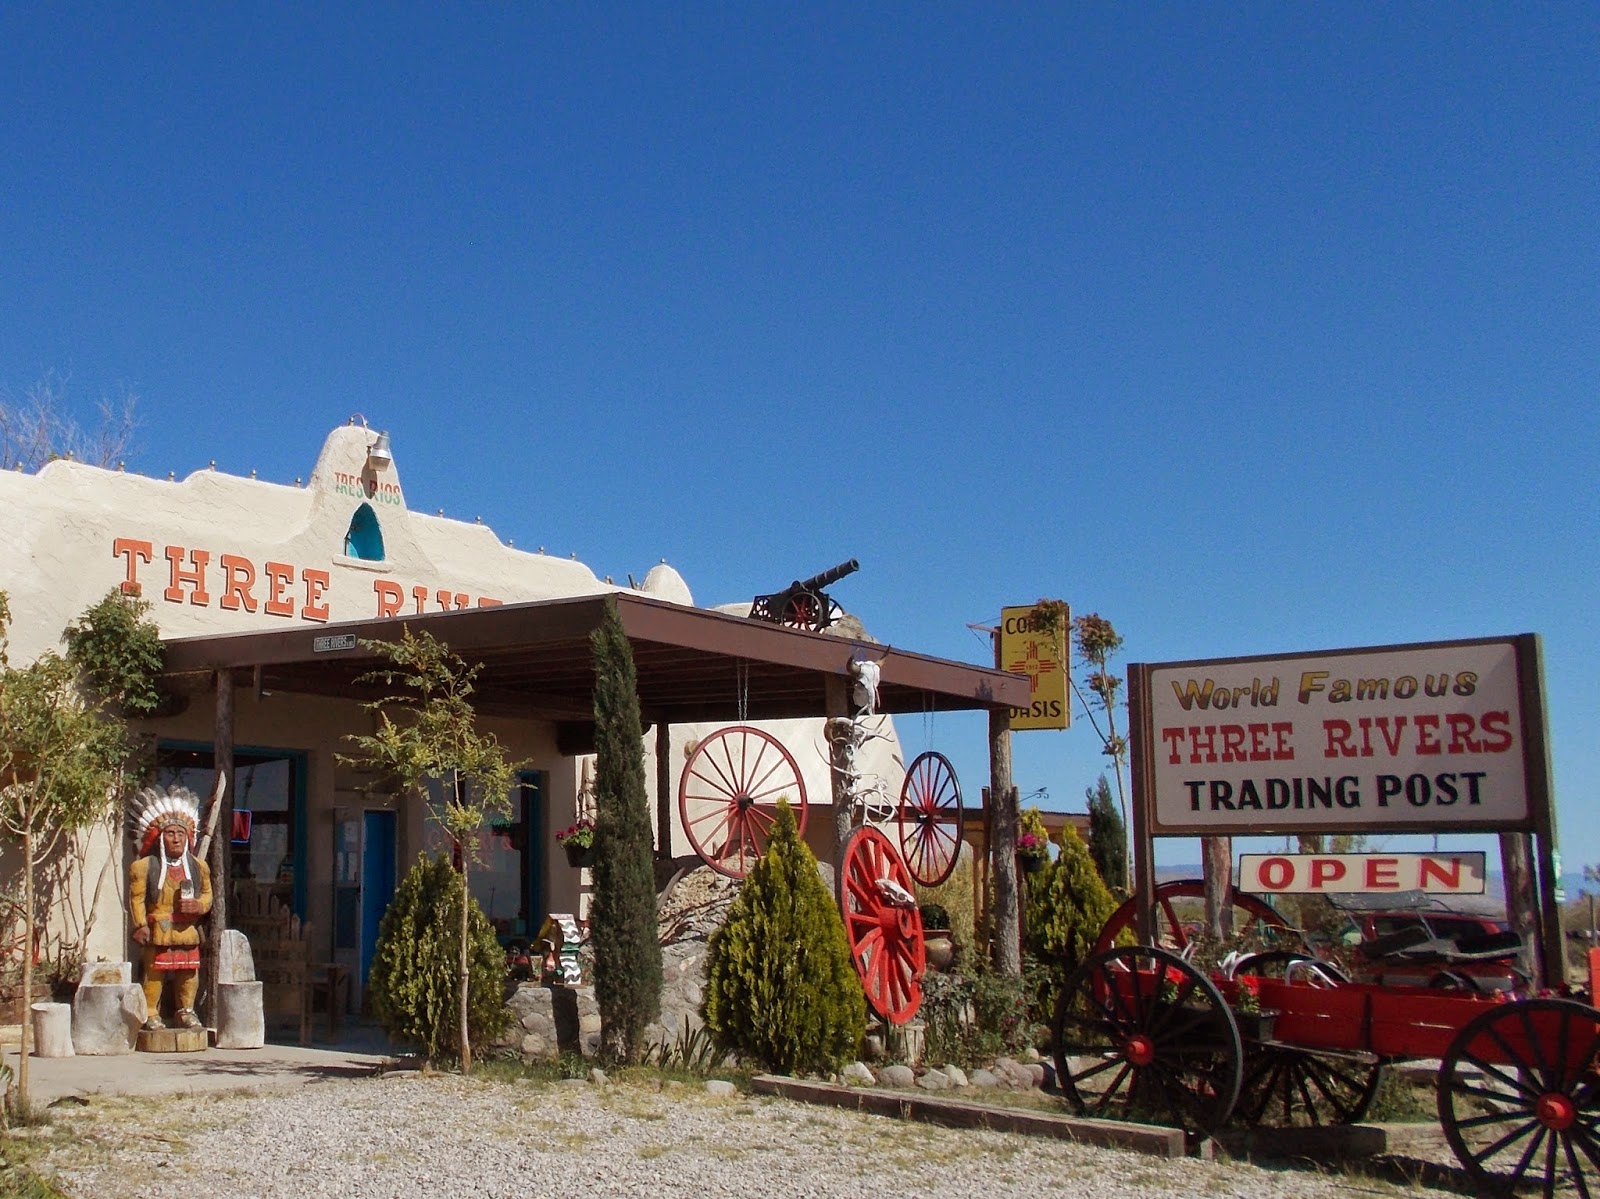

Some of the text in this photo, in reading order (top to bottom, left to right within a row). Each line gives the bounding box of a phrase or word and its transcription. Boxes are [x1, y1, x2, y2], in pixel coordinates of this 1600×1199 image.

[335, 472, 400, 505] TRES RIOS
[113, 537, 331, 622] THREE
[316, 638, 330, 650] THREE
[331, 636, 347, 649] RIVERS
[1171, 671, 1478, 711] World Famous
[1162, 710, 1513, 765] THREE RIVERS
[1184, 771, 1487, 811] TRADING POST
[1257, 857, 1461, 891] OPEN
